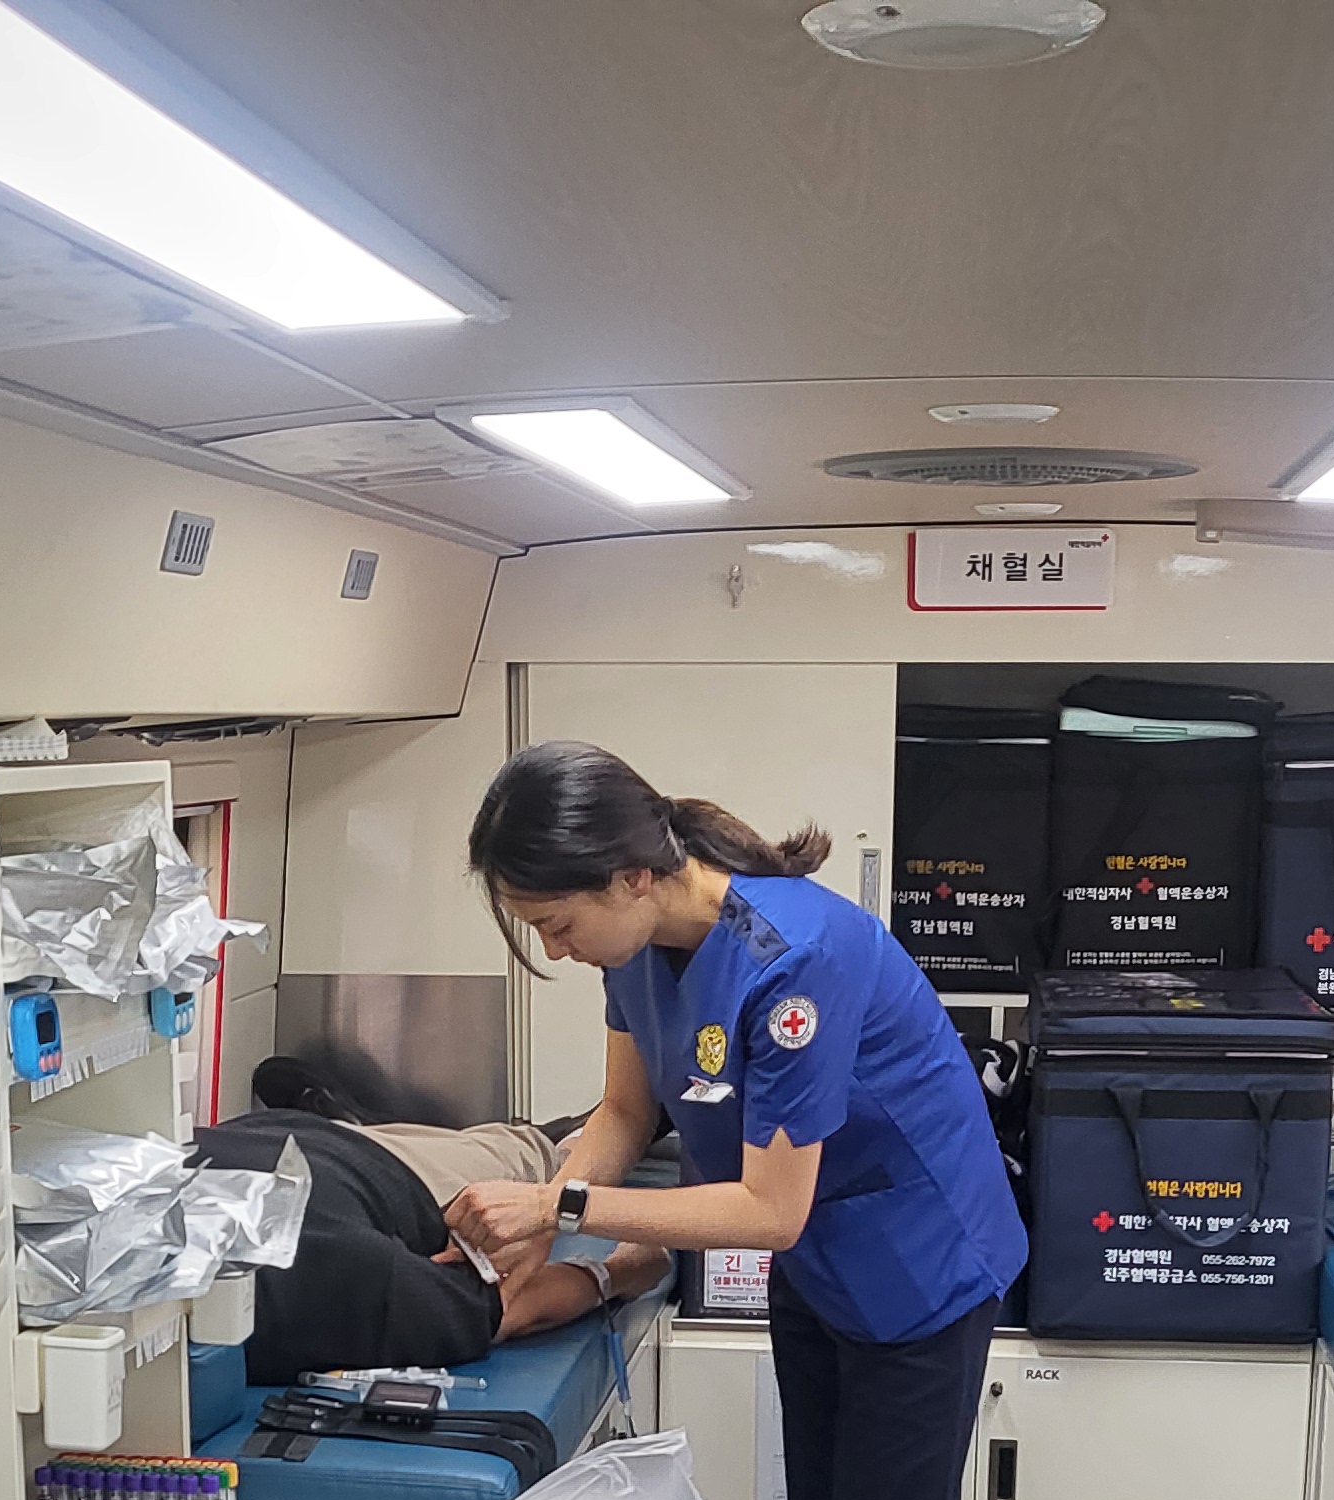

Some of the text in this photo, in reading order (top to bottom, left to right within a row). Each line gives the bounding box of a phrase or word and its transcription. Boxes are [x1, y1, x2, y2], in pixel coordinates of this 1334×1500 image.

[965, 551, 1064, 582] 채혈실
[1137, 855, 1187, 870] 사랑입니다
[954, 892, 1025, 908] 혈액운송상자
[1157, 886, 1229, 900] 혈액운송상자
[910, 919, 974, 936] 경남혈액원
[1110, 915, 1177, 931] 경남혈액원
[1182, 1181, 1242, 1198] 사랑입니다
[1104, 1249, 1276, 1267] 경남혈액원 055-262-7972
[1102, 1266, 1275, 1285] 진주혈액공급소 055-756-1201
[1026, 1369, 1060, 1381] RACK
